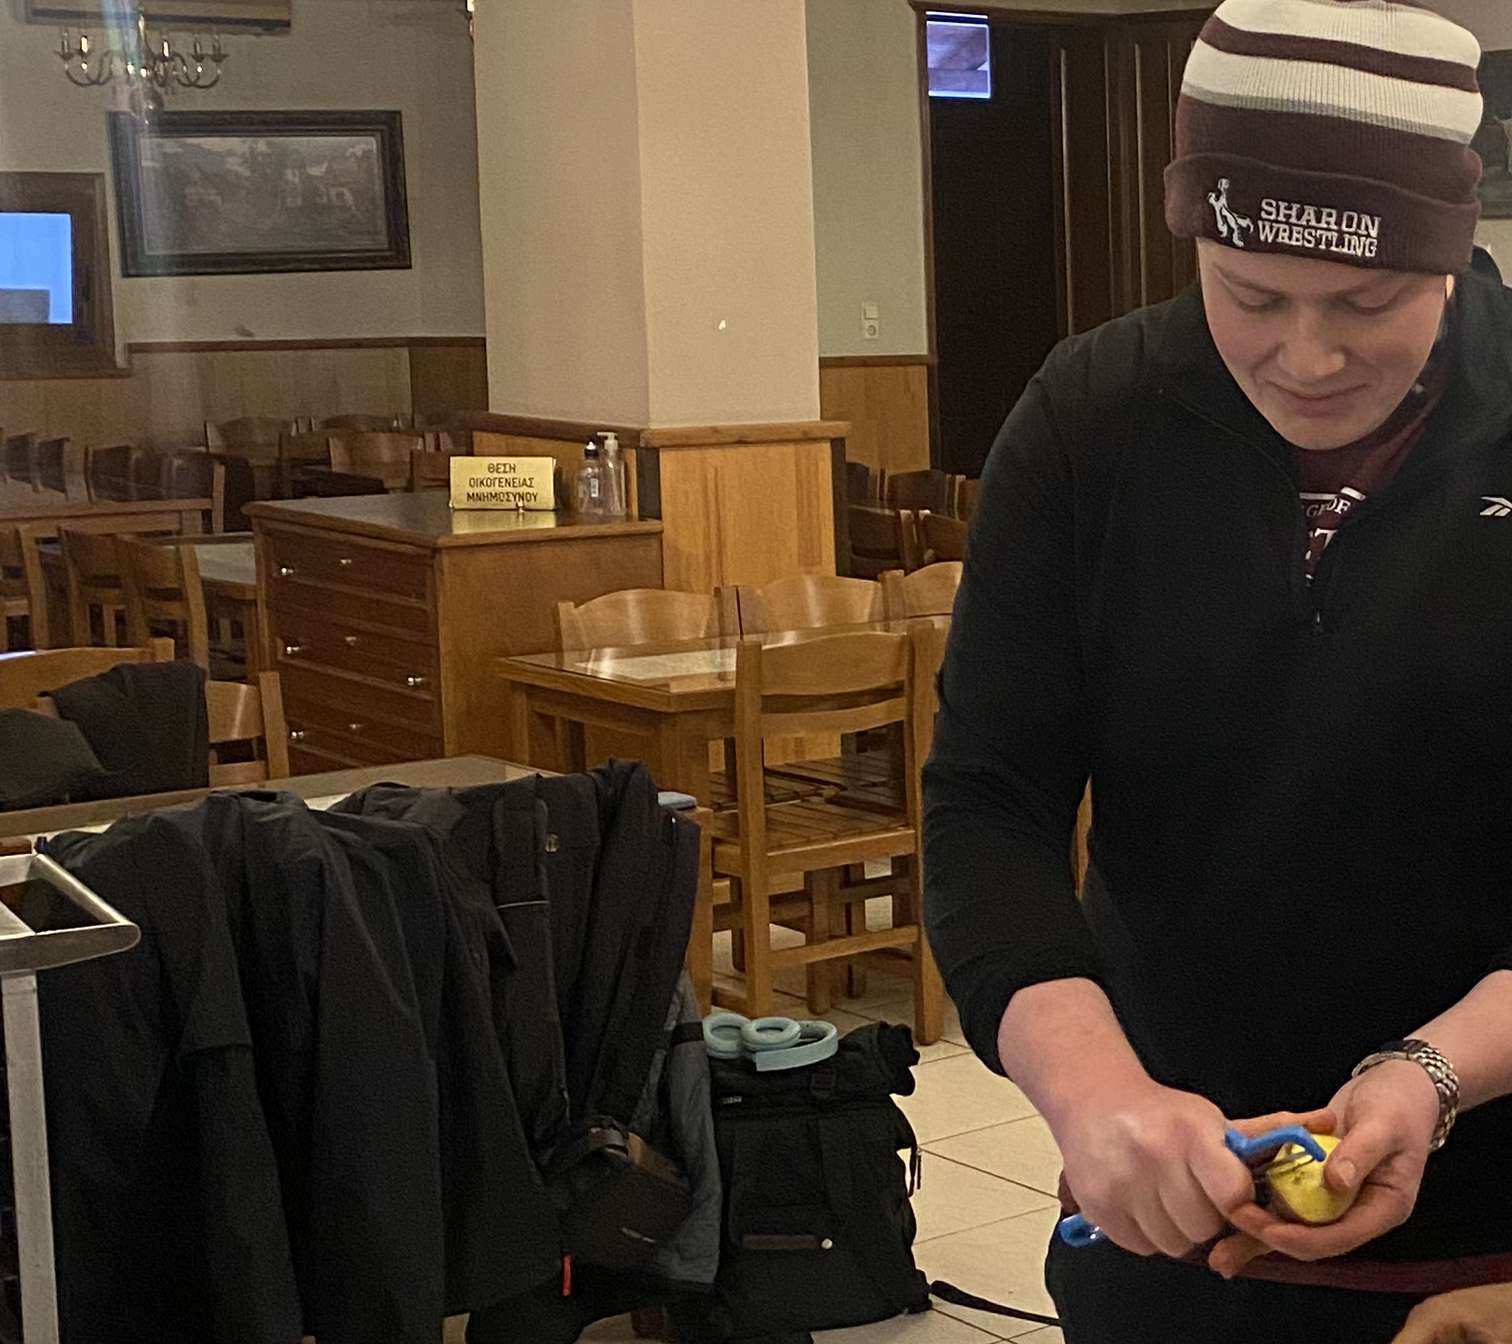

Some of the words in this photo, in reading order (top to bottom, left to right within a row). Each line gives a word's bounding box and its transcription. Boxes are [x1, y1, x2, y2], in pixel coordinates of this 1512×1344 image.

[1260, 198, 1381, 238] SHARON
[1257, 220, 1378, 257] WRESTLING
[487, 462, 517, 474] ΘΕΣΗ
[468, 477, 535, 489] ΟΙΚΟΓΕΝΕΙΑΣ
[466, 491, 539, 503] ΜΝΗΜΟΣΥΝΟΥ
